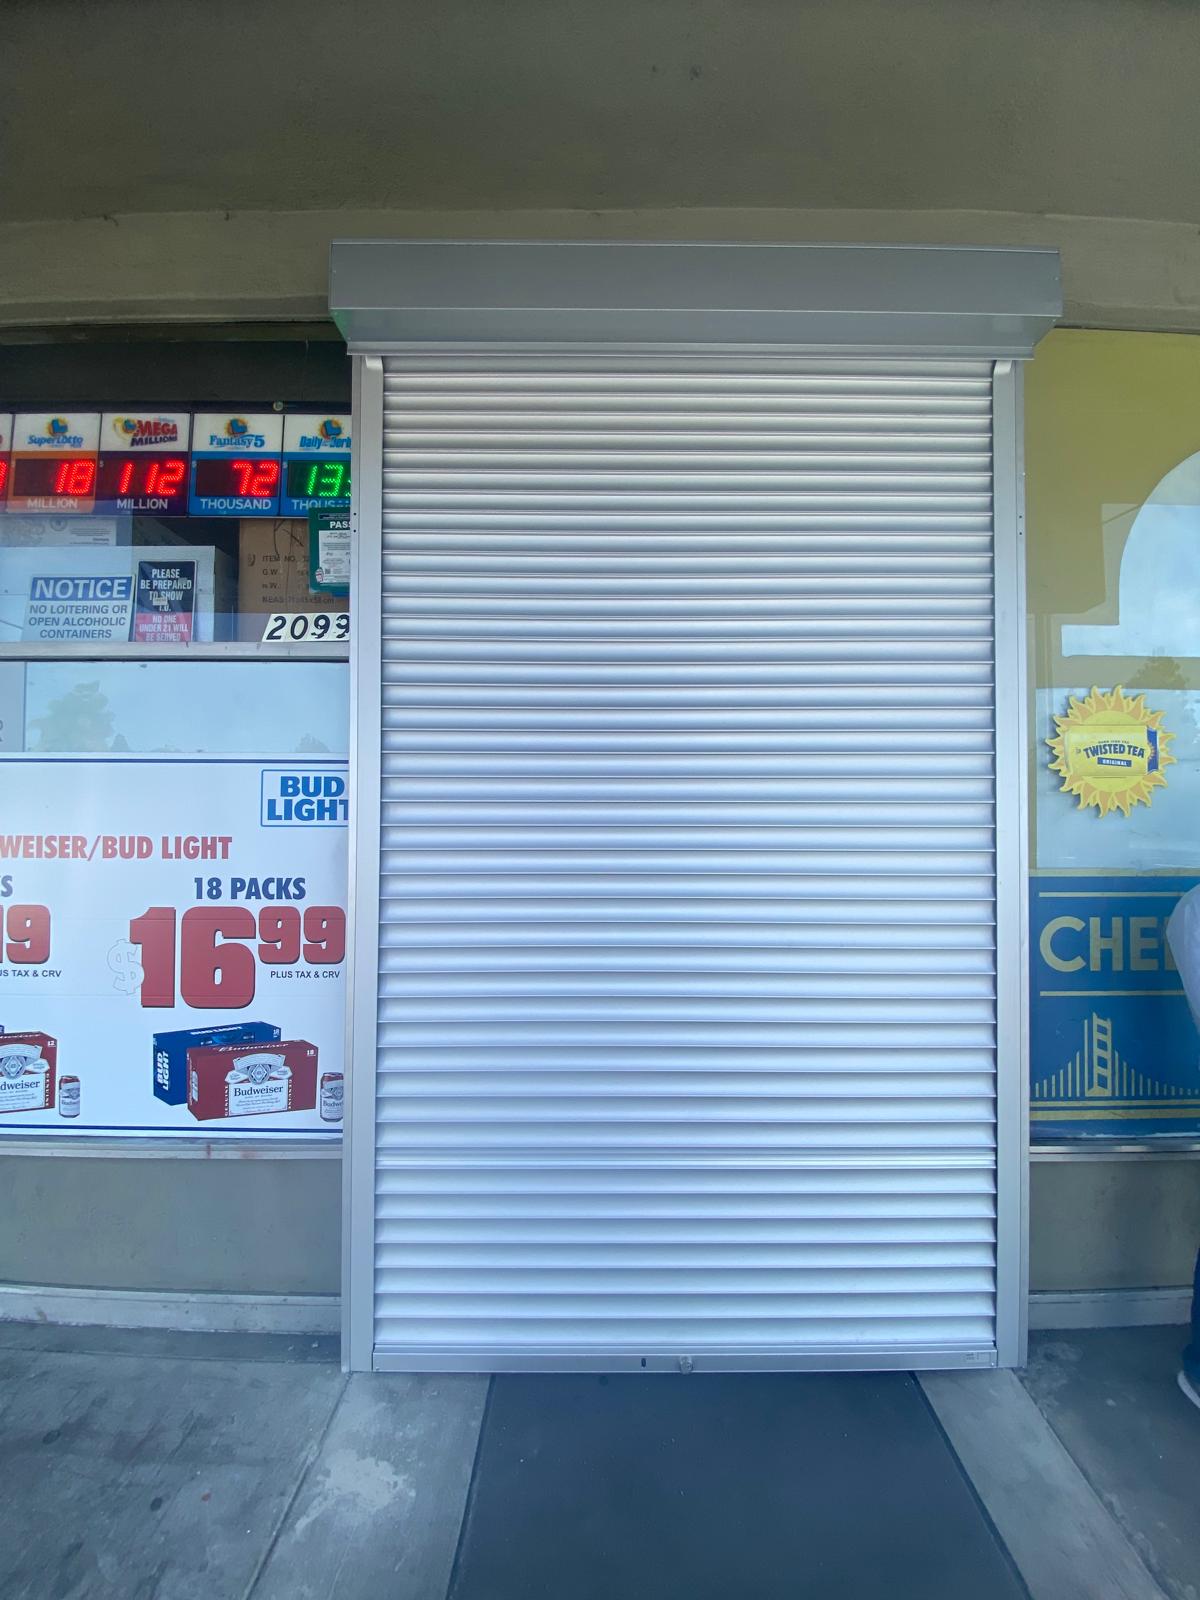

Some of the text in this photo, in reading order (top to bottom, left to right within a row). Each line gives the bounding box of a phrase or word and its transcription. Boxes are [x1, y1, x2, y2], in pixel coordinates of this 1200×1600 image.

[134, 420, 178, 438] MEGA
[209, 434, 266, 448] Fantasy 5
[299, 436, 323, 450] Daily
[55, 461, 96, 494] 18
[120, 461, 186, 494] 112
[232, 461, 279, 495] 72
[27, 499, 78, 509] MILLION
[117, 499, 168, 509] MILLION
[200, 499, 272, 510] THOUSAND
[151, 568, 180, 578] PLEASE
[34, 578, 127, 599] NOTICE
[140, 579, 151, 590] BE
[149, 590, 184, 601] TO SHOW
[29, 604, 128, 615] NO LOITERING OR
[28, 617, 126, 627] OPEN ALCOHOLIC
[152, 614, 177, 624] NO ONE
[139, 623, 188, 633] UNDER 21 WILL
[39, 629, 112, 640] CONTAINERS
[1083, 743, 1126, 759] TWISTED
[1127, 744, 1145, 759] TEA
[280, 775, 345, 798] BUD
[161, 836, 233, 860] LIGHT
[194, 877, 307, 901] 18 PACKS
[11, 969, 31, 977] TAX
[32, 969, 39, 977] &
[41, 969, 62, 978] CRV
[270, 970, 341, 979] PLUS TAX & CRV
[156, 1052, 165, 1085] BUD
[162, 1050, 170, 1091] LIGHT
[233, 1085, 284, 1097] Budweiser
